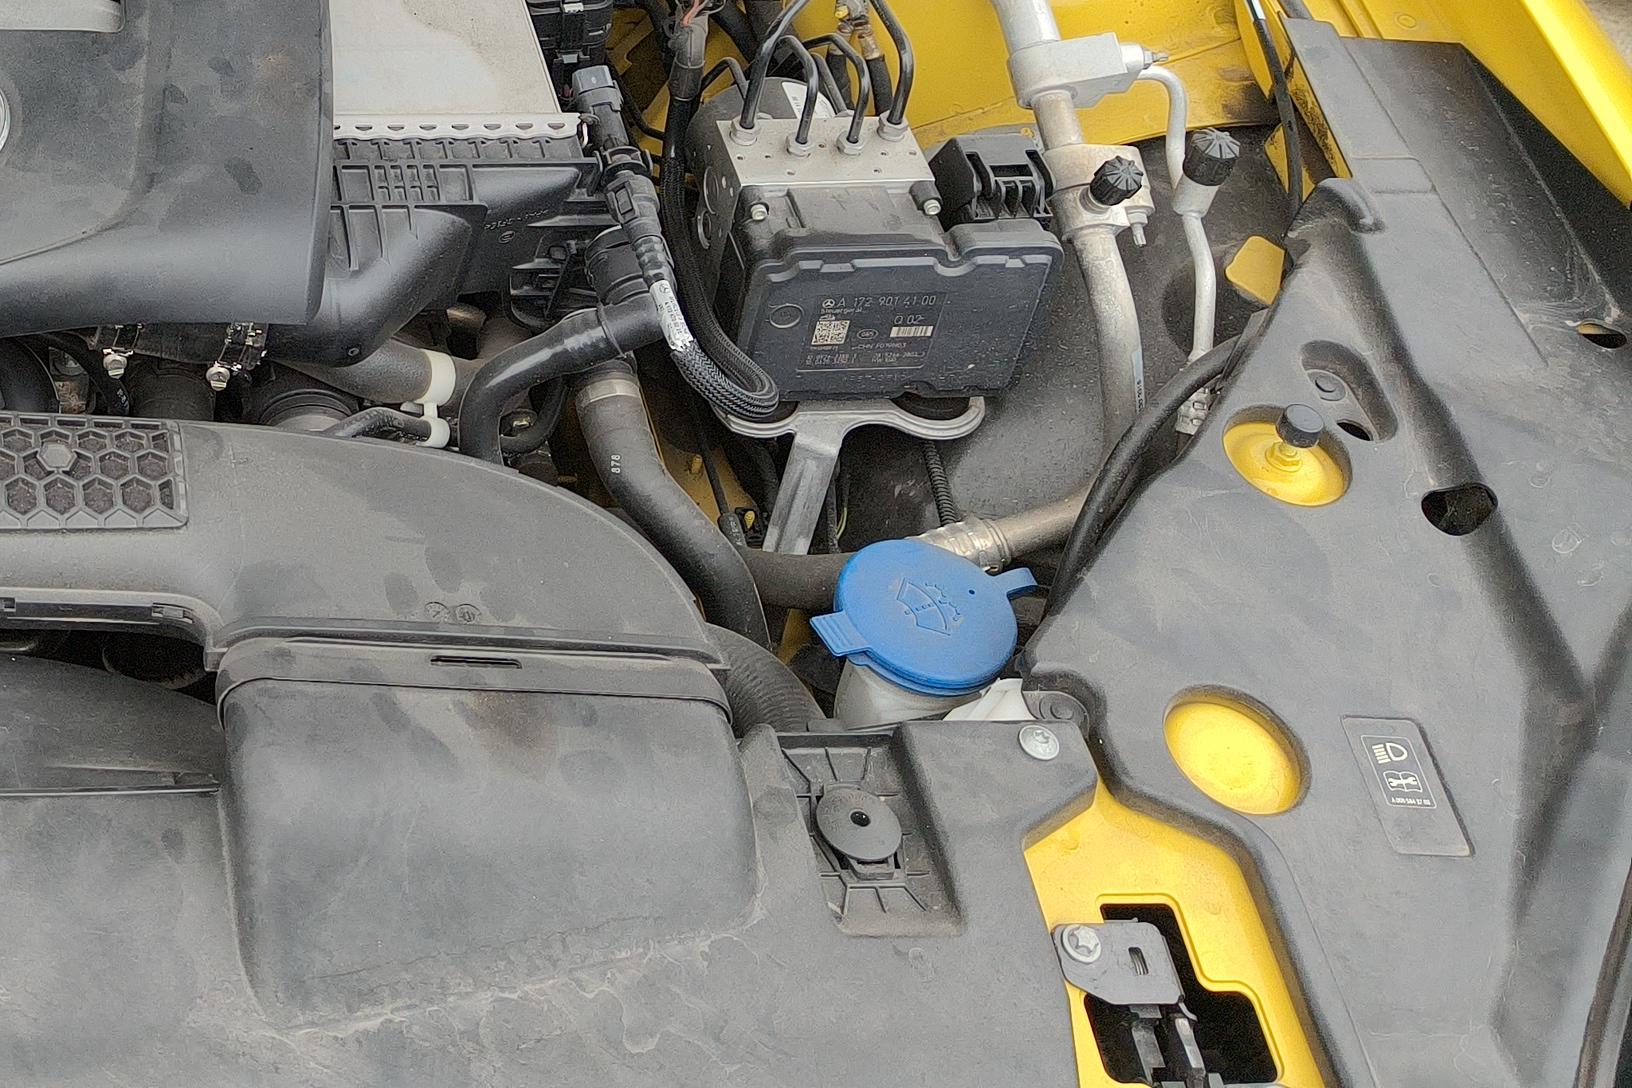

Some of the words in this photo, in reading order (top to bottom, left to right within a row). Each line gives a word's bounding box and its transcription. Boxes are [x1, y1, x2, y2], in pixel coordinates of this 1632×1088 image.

[837, 298, 846, 307] A
[854, 297, 872, 306] 172
[922, 295, 936, 305] 00
[610, 454, 622, 474] 878
